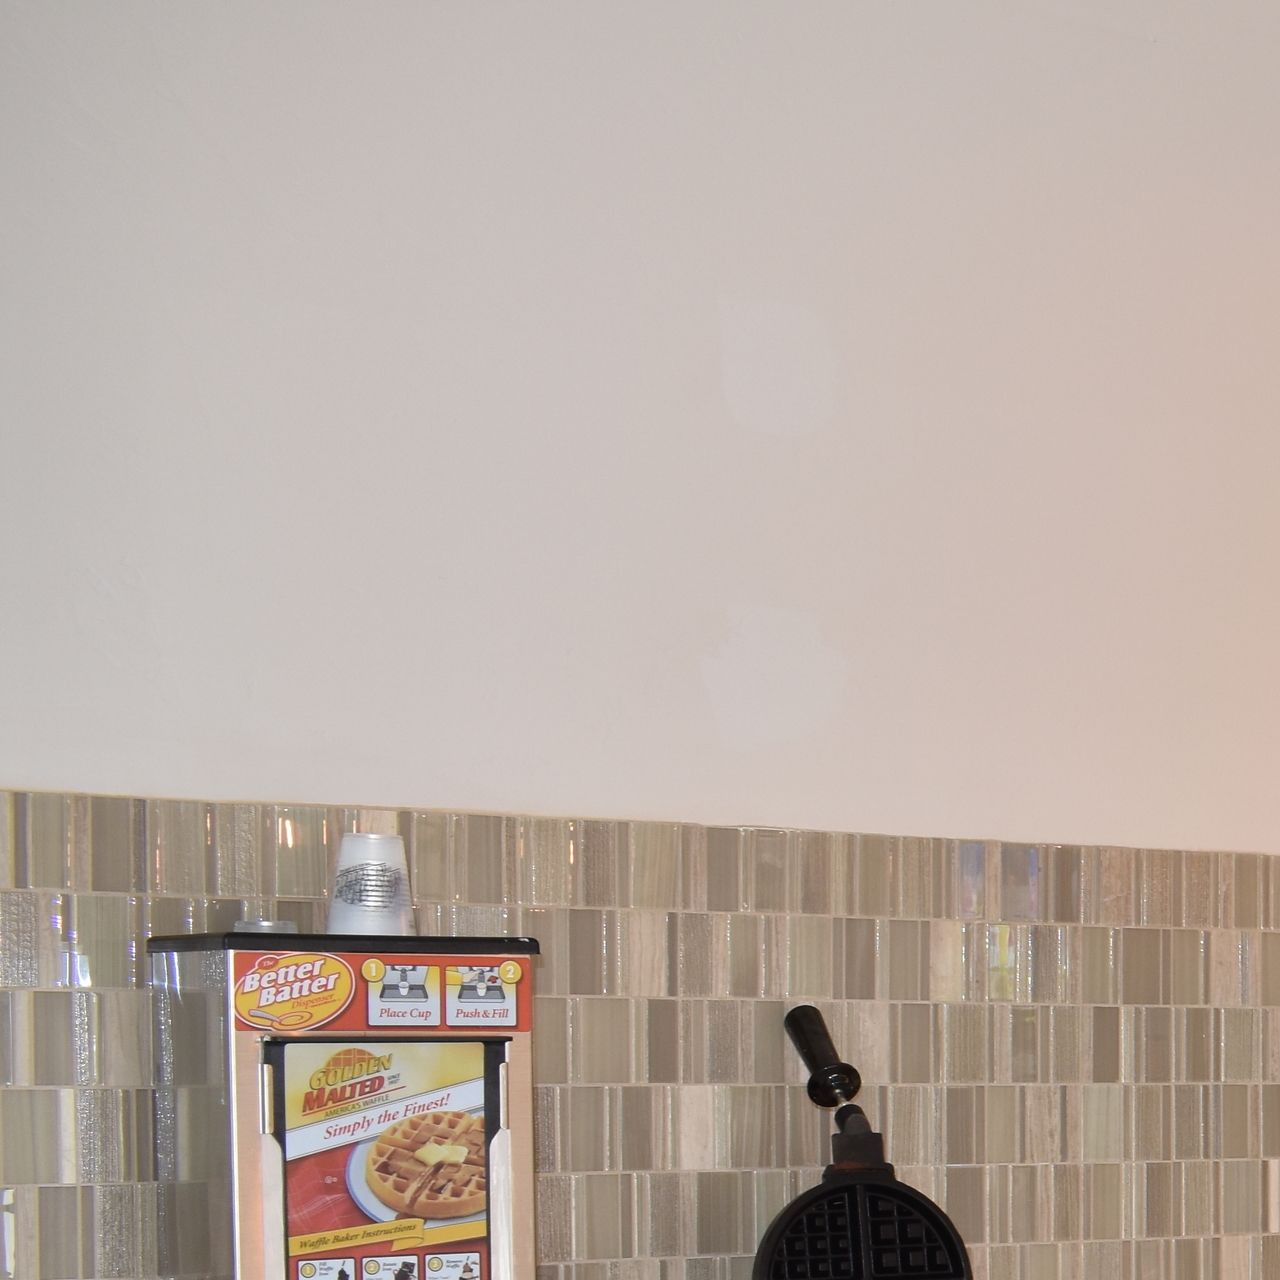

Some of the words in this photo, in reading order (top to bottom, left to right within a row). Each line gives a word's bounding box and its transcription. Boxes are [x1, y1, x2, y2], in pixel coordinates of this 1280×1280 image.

[242, 959, 326, 994] Better
[258, 973, 340, 1008] Batter
[378, 1008, 408, 1020] Place
[409, 1009, 432, 1021] Cup
[455, 1008, 481, 1019] Push
[482, 1009, 490, 1018] &
[491, 1009, 509, 1018] Fill
[309, 1053, 393, 1091] GOLDEN
[302, 1075, 385, 1113] MALTED
[323, 1117, 374, 1140] Simply
[377, 1108, 400, 1125] the
[402, 1093, 451, 1118] Finest!
[299, 1236, 331, 1249] Waffle
[331, 1232, 360, 1244] Baker
[360, 1223, 417, 1240] Instructions
